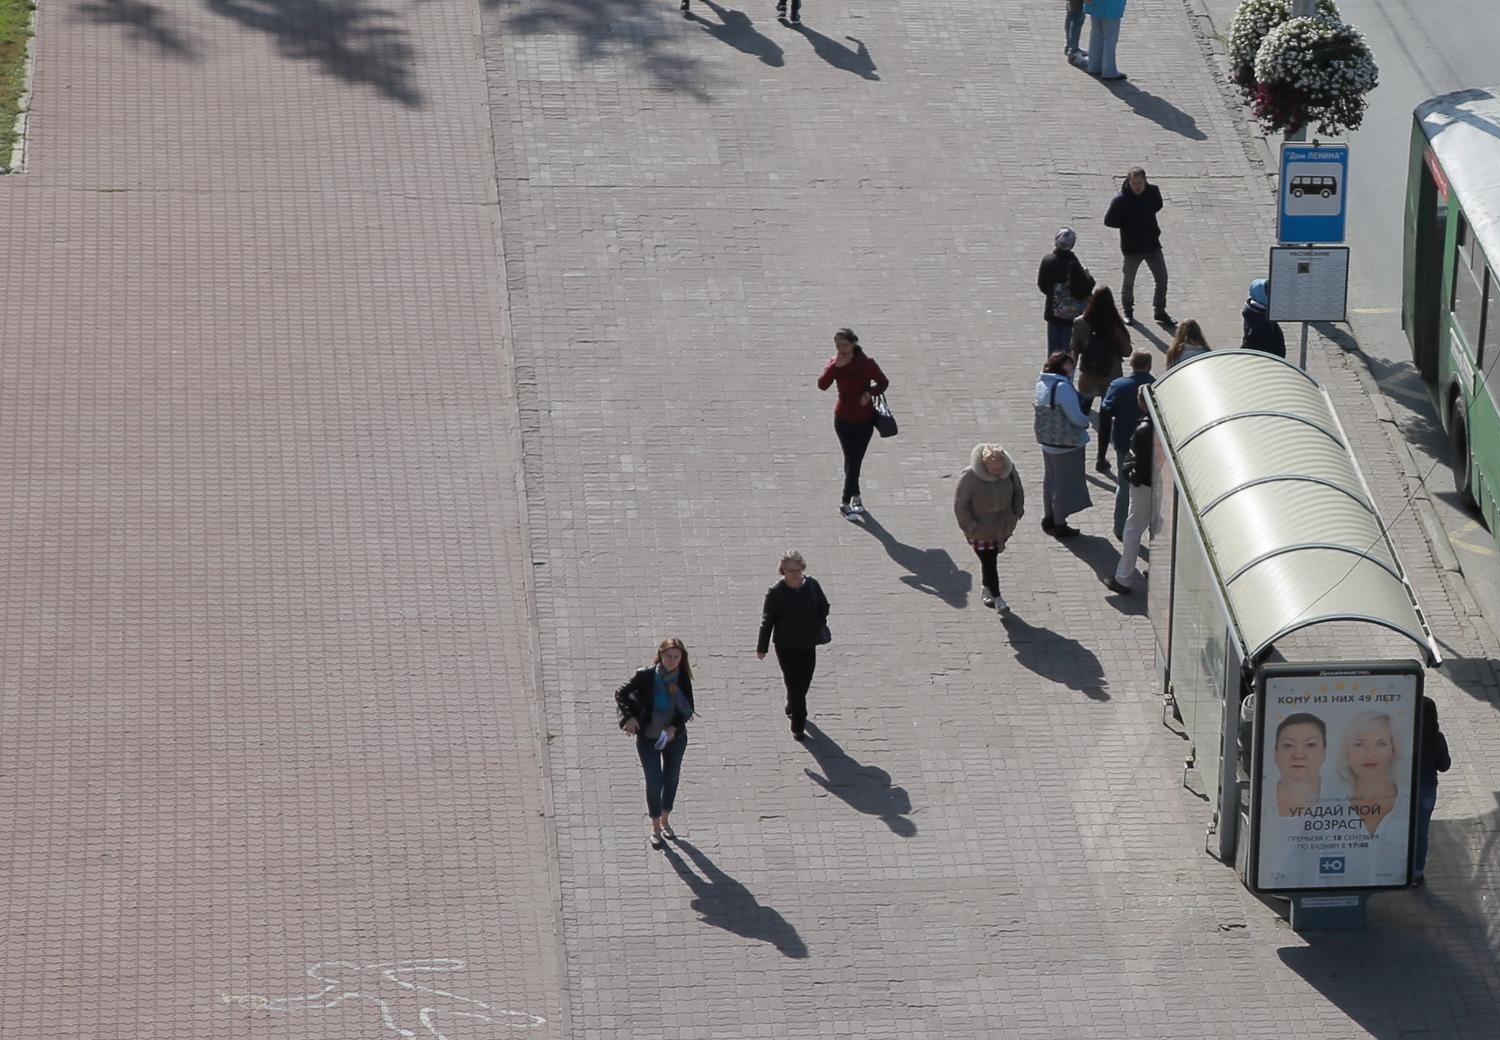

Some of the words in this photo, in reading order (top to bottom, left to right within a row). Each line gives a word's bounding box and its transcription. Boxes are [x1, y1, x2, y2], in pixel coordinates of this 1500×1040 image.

[1277, 696, 1310, 704] КОМУ
[1313, 695, 1328, 703] ИЗ
[1331, 695, 1355, 703] НИХ
[1358, 694, 1371, 702] 49
[1375, 694, 1402, 702] ЛЕТ?
[1289, 804, 1343, 818] УГАДАЙ
[1348, 803, 1381, 816] МОЙ
[1304, 818, 1365, 831] ВОЗРАСТ
[1310, 842, 1340, 850] БУДНЯМ
